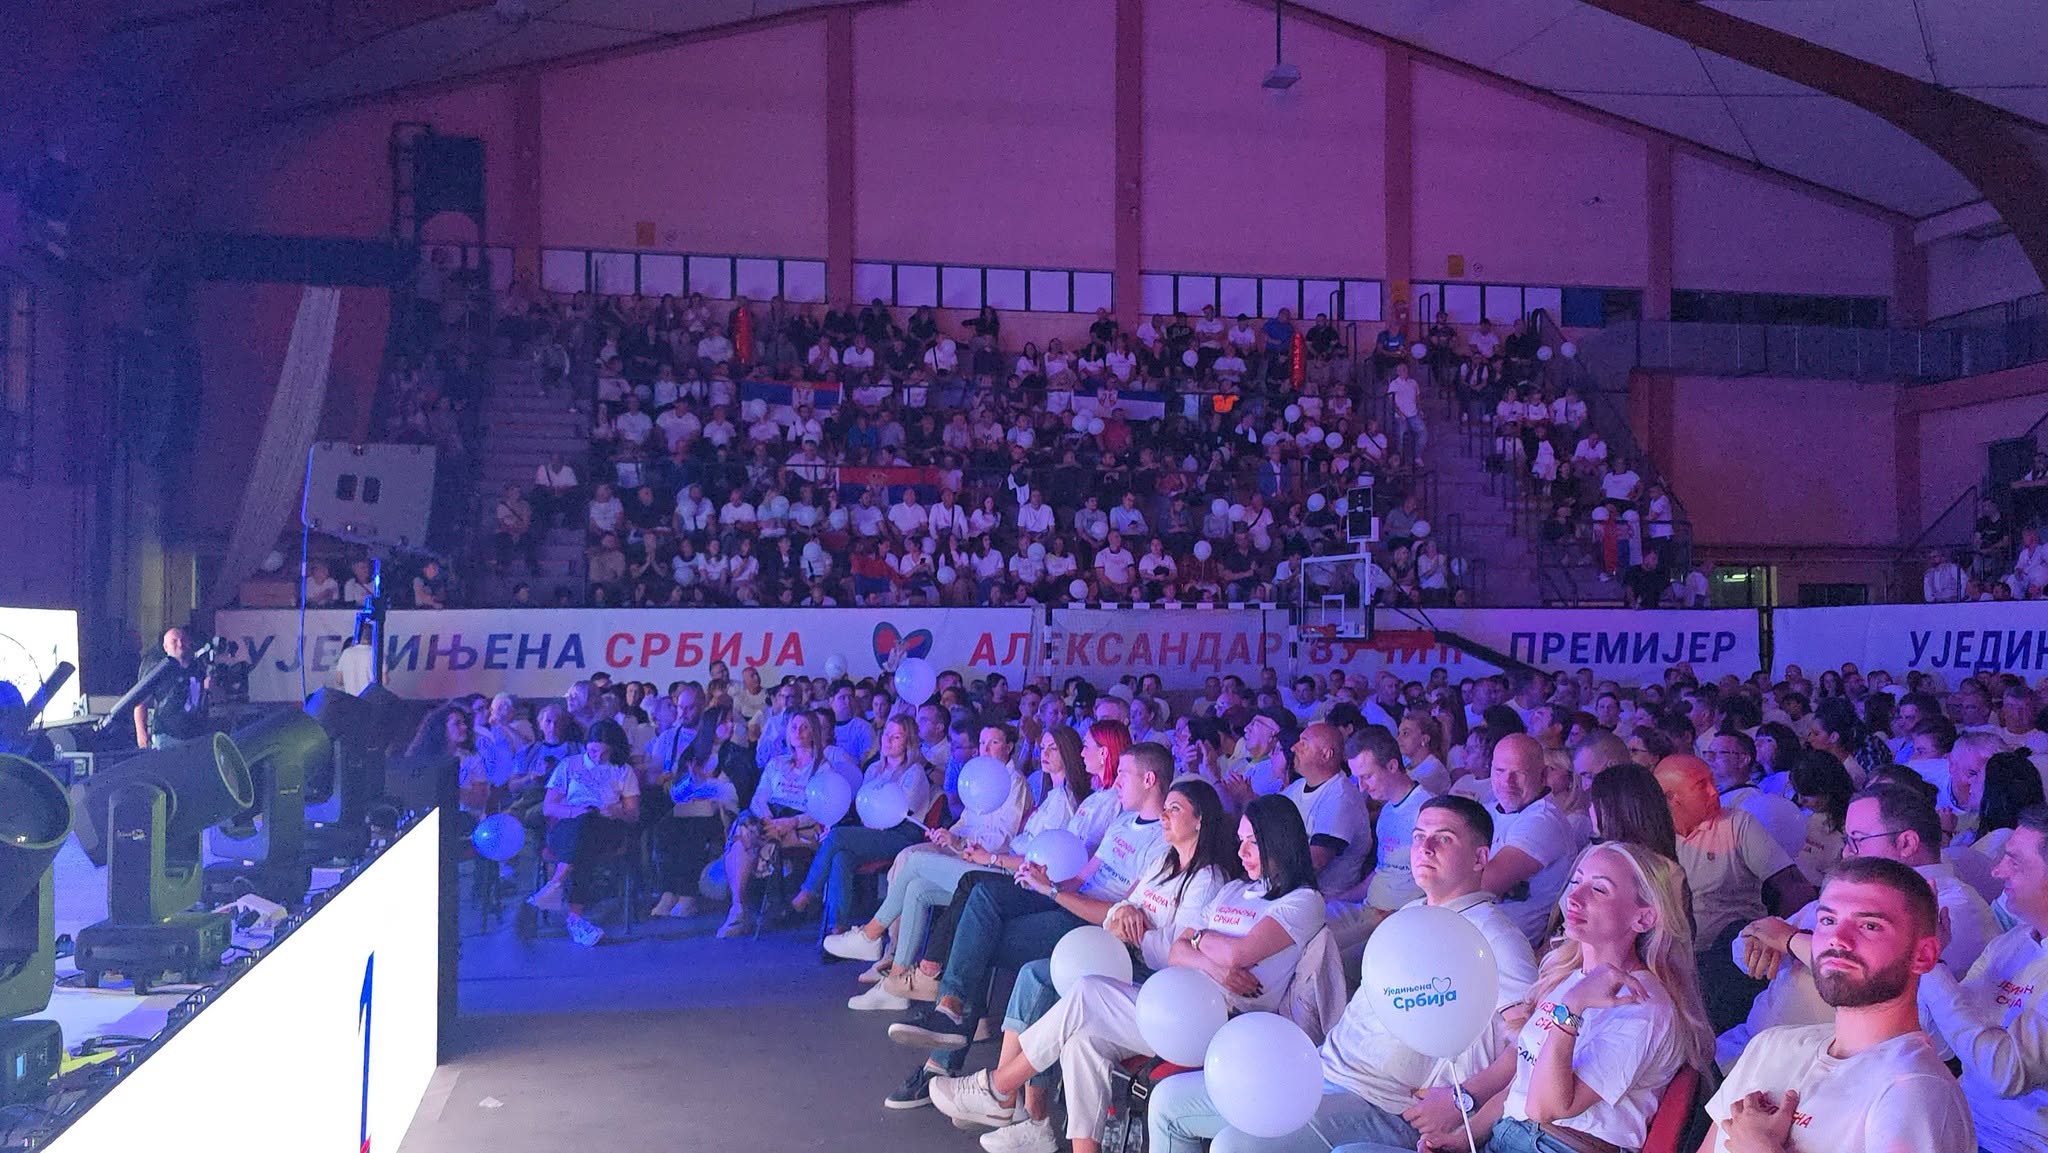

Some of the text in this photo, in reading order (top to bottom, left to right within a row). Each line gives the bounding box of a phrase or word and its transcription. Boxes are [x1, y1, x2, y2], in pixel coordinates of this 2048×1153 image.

[243, 631, 805, 672] УЈЕИЊЕНА СРБИЈА
[1509, 631, 1737, 664] ПРЕМИЈЕР
[1383, 983, 1432, 997] Уједињена
[1392, 989, 1457, 1012] Србија
